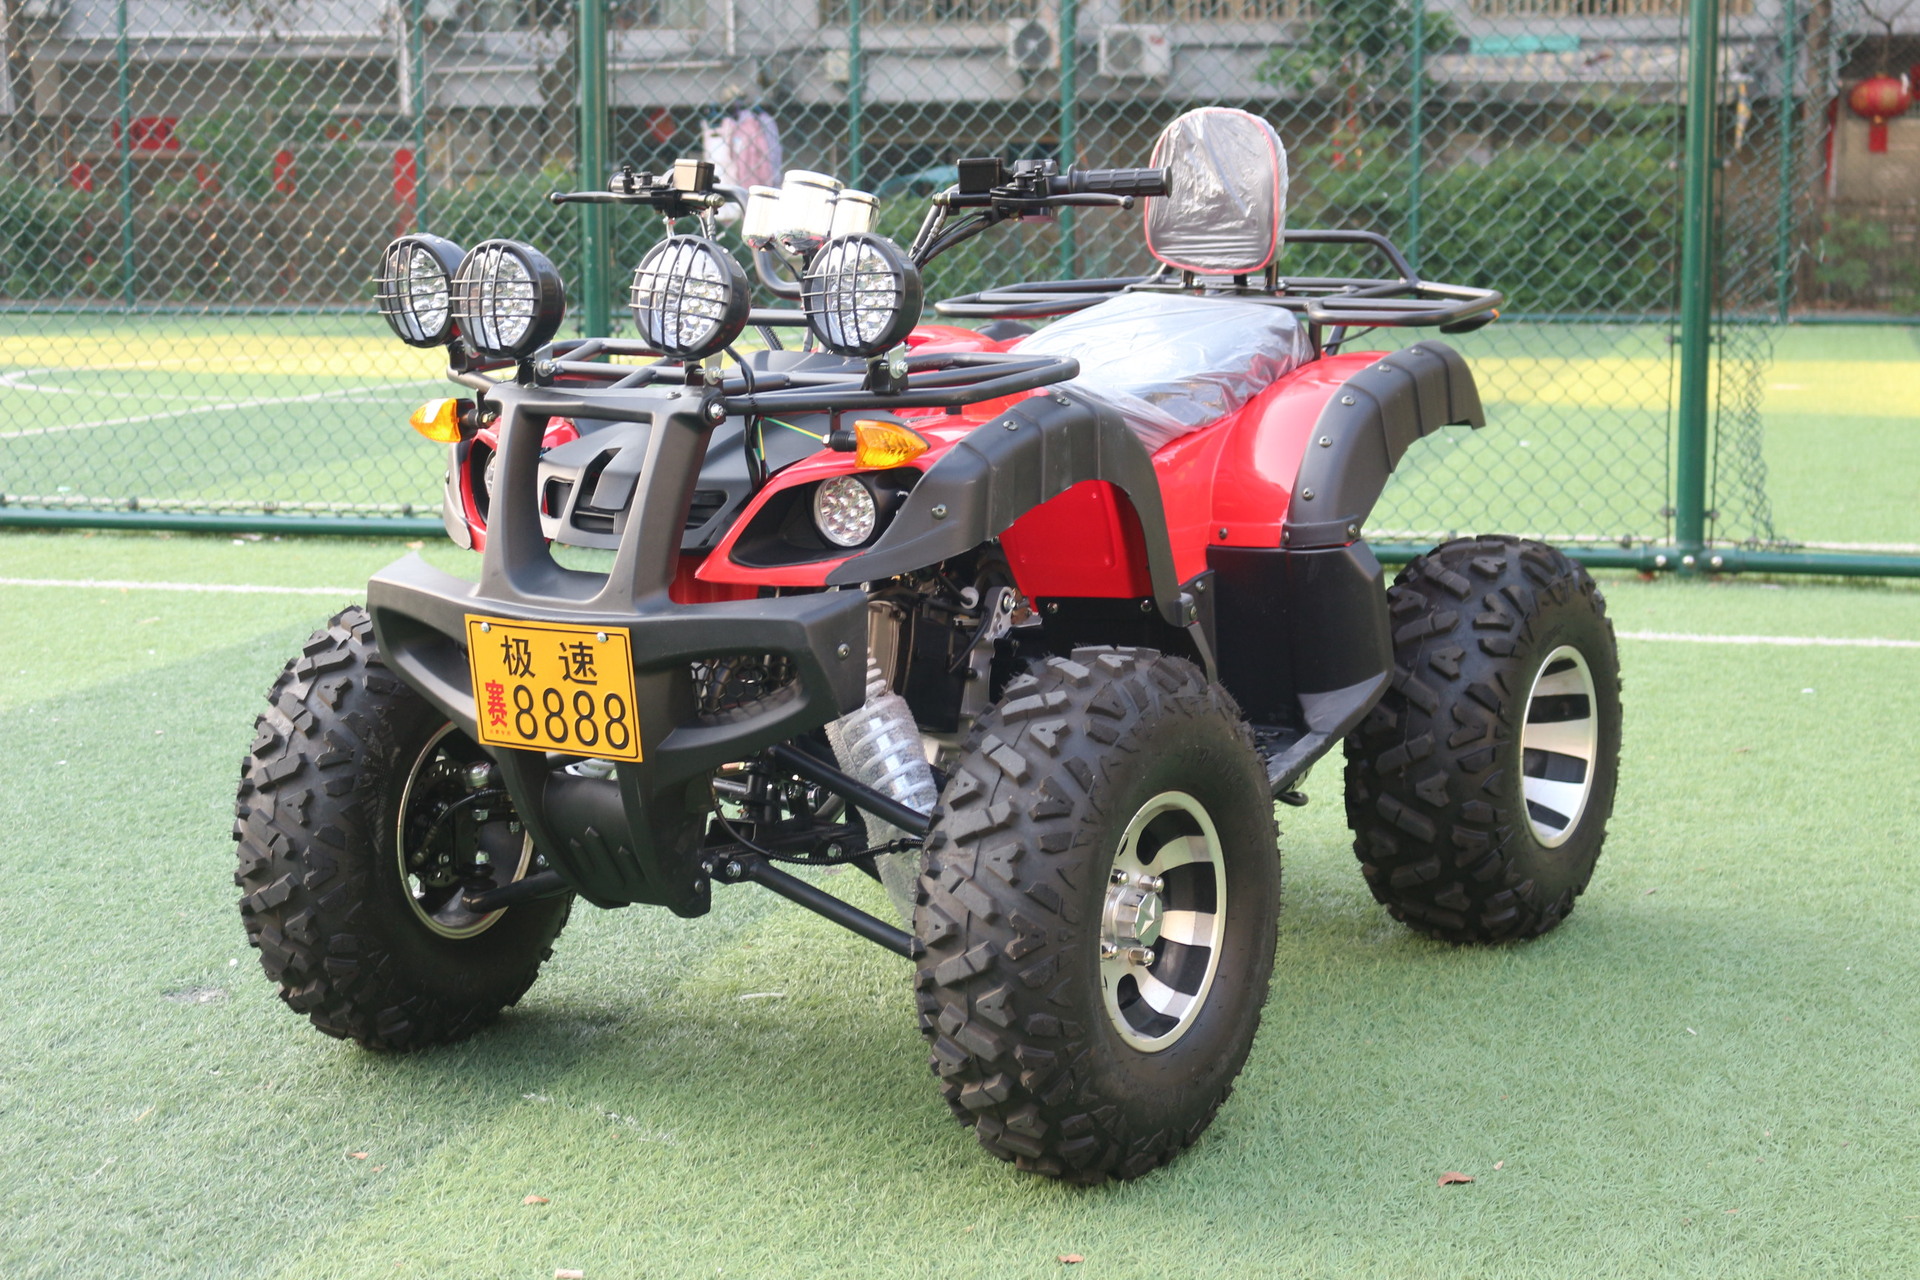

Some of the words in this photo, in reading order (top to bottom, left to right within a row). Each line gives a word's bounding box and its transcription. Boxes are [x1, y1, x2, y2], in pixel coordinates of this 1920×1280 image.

[500, 635, 598, 684] 极速
[485, 679, 508, 727] 赛
[513, 684, 629, 750] 8888
